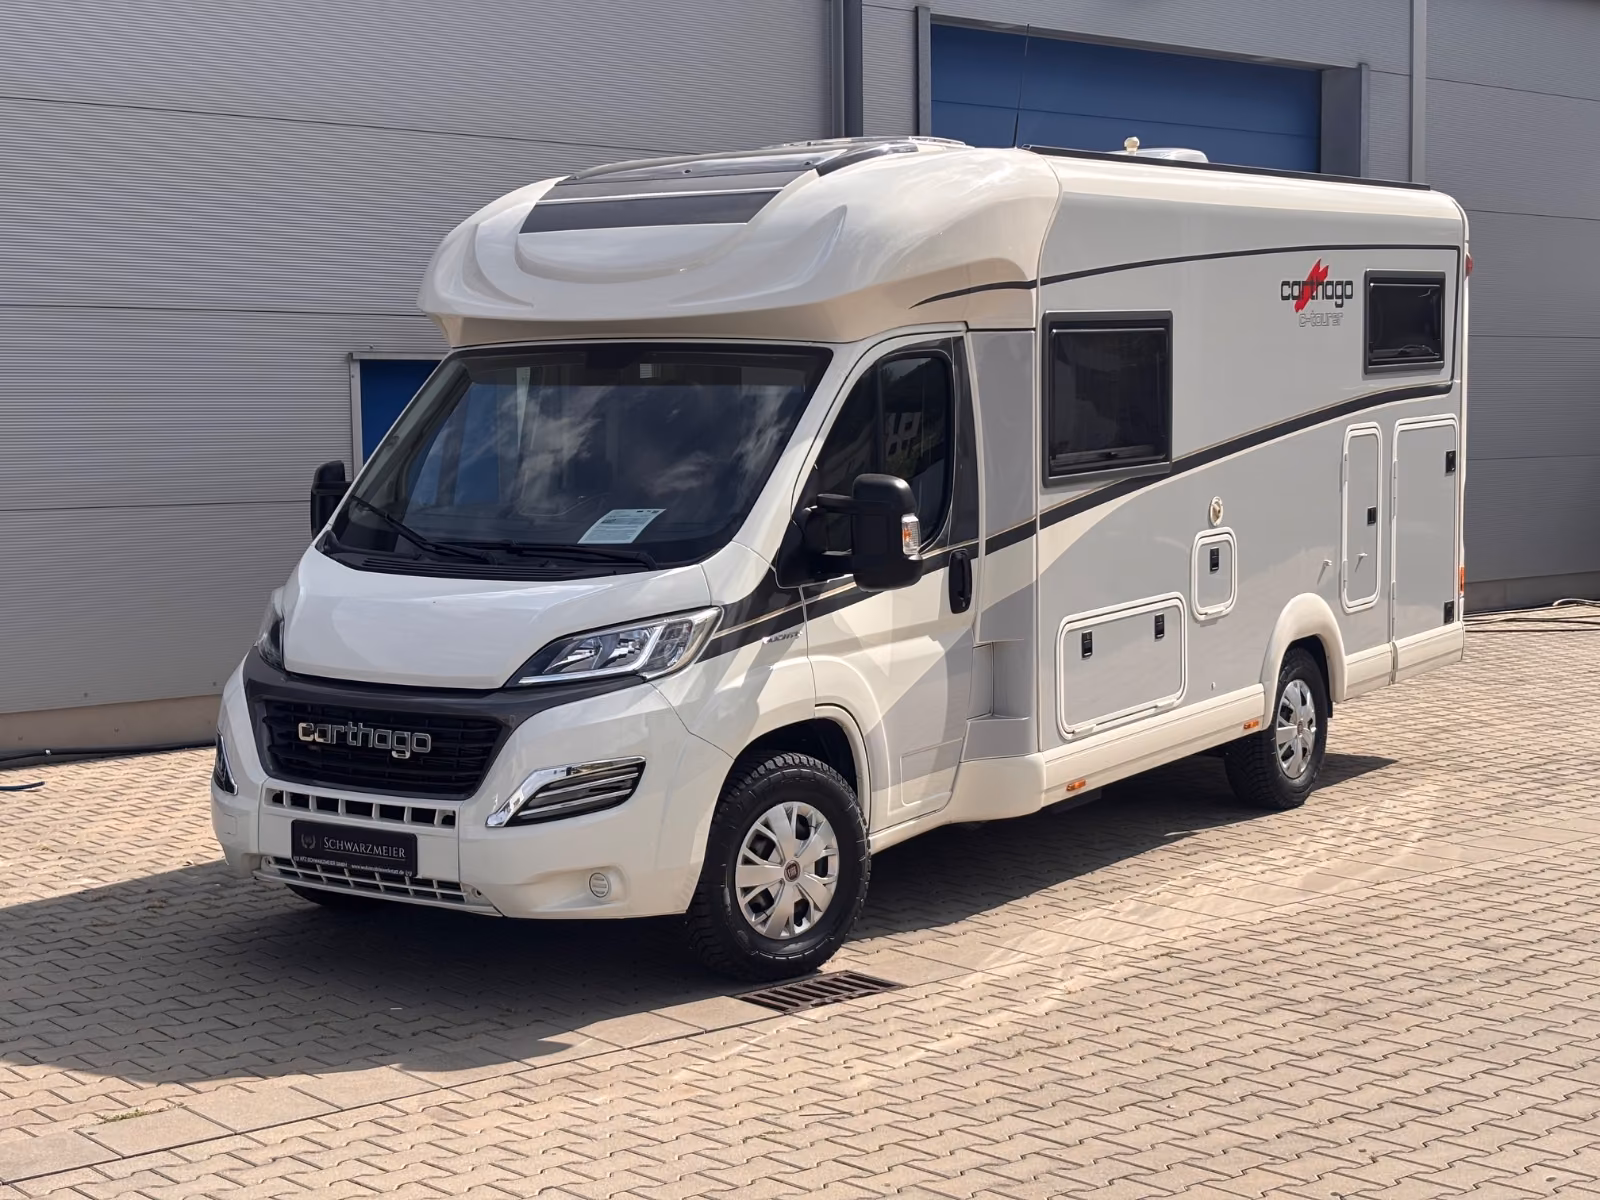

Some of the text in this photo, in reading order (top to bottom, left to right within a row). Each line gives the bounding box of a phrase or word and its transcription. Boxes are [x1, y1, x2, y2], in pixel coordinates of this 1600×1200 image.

[1281, 280, 1353, 308] carthago
[298, 721, 432, 759] carthago
[323, 836, 406, 858] SCHWARZMEIER
